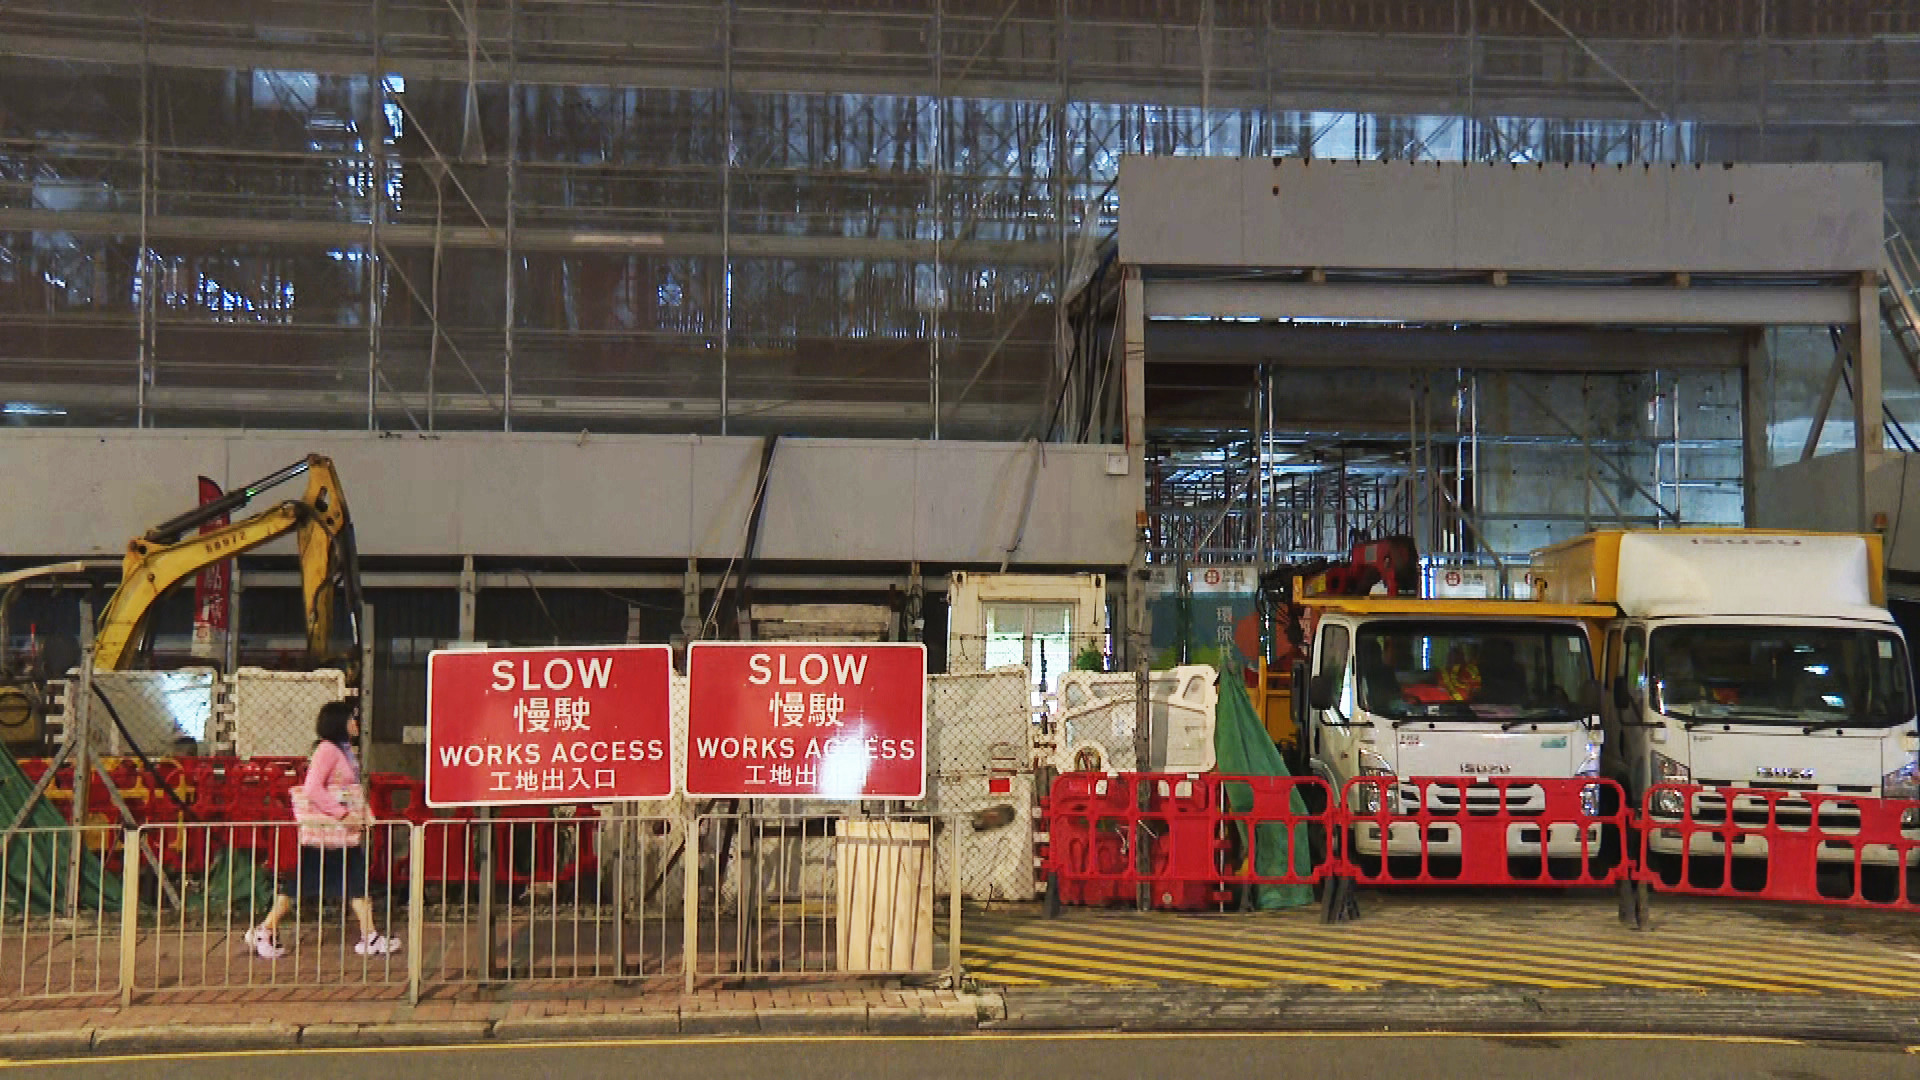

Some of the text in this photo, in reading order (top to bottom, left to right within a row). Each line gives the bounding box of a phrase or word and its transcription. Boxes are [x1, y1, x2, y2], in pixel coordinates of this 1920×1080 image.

[491, 657, 613, 691] SLOW
[748, 653, 868, 685] SLOW
[513, 696, 591, 733] 慢駛
[769, 691, 845, 727] 慢駛
[439, 740, 664, 767] WORKS ACCESS
[696, 737, 915, 760] WORKS ACESS
[489, 767, 616, 791] 工地出入口
[744, 763, 867, 787] 工地出
[1459, 762, 1512, 774] ISUZU
[1756, 766, 1816, 779] ISUZU
